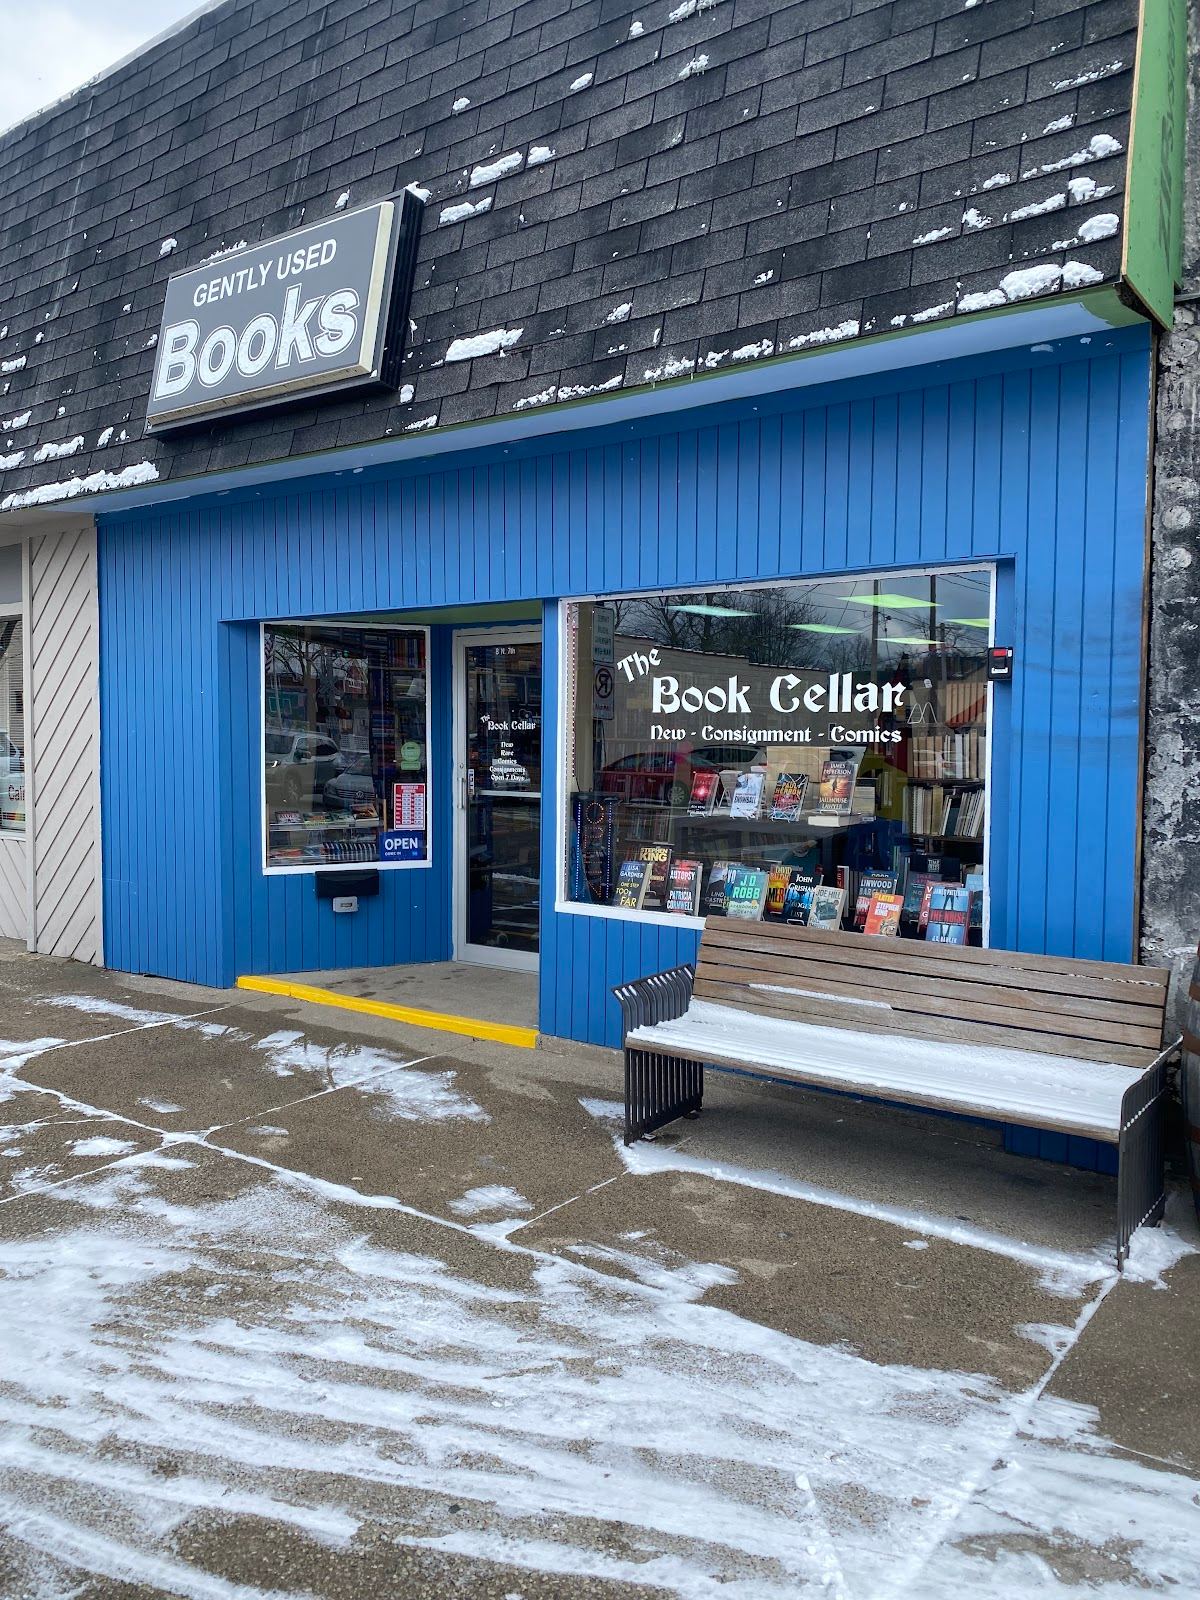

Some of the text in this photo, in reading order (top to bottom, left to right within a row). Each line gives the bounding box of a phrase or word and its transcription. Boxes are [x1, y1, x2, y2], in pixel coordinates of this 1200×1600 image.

[193, 238, 337, 307] GENTLY USED
[153, 283, 360, 401] Books
[617, 648, 662, 683] The
[651, 672, 906, 714] Book Cellar
[487, 720, 536, 731] Book Cellar
[650, 725, 686, 741] New
[701, 725, 811, 744] Consignment
[830, 725, 902, 743] Comics
[490, 774, 505, 782] Open
[510, 774, 526, 782] Days
[384, 837, 418, 851] OPEN
[639, 852, 668, 862] KING
[669, 870, 696, 880] AUTOPSY
[795, 873, 814, 883] JOHN
[860, 879, 892, 889] LINWOOD
[669, 891, 692, 901] PATRICIA
[732, 887, 760, 899] ROBB
[828, 889, 841, 900] HILL
[619, 896, 637, 907] FAR
[666, 900, 694, 911] CORNWELL
